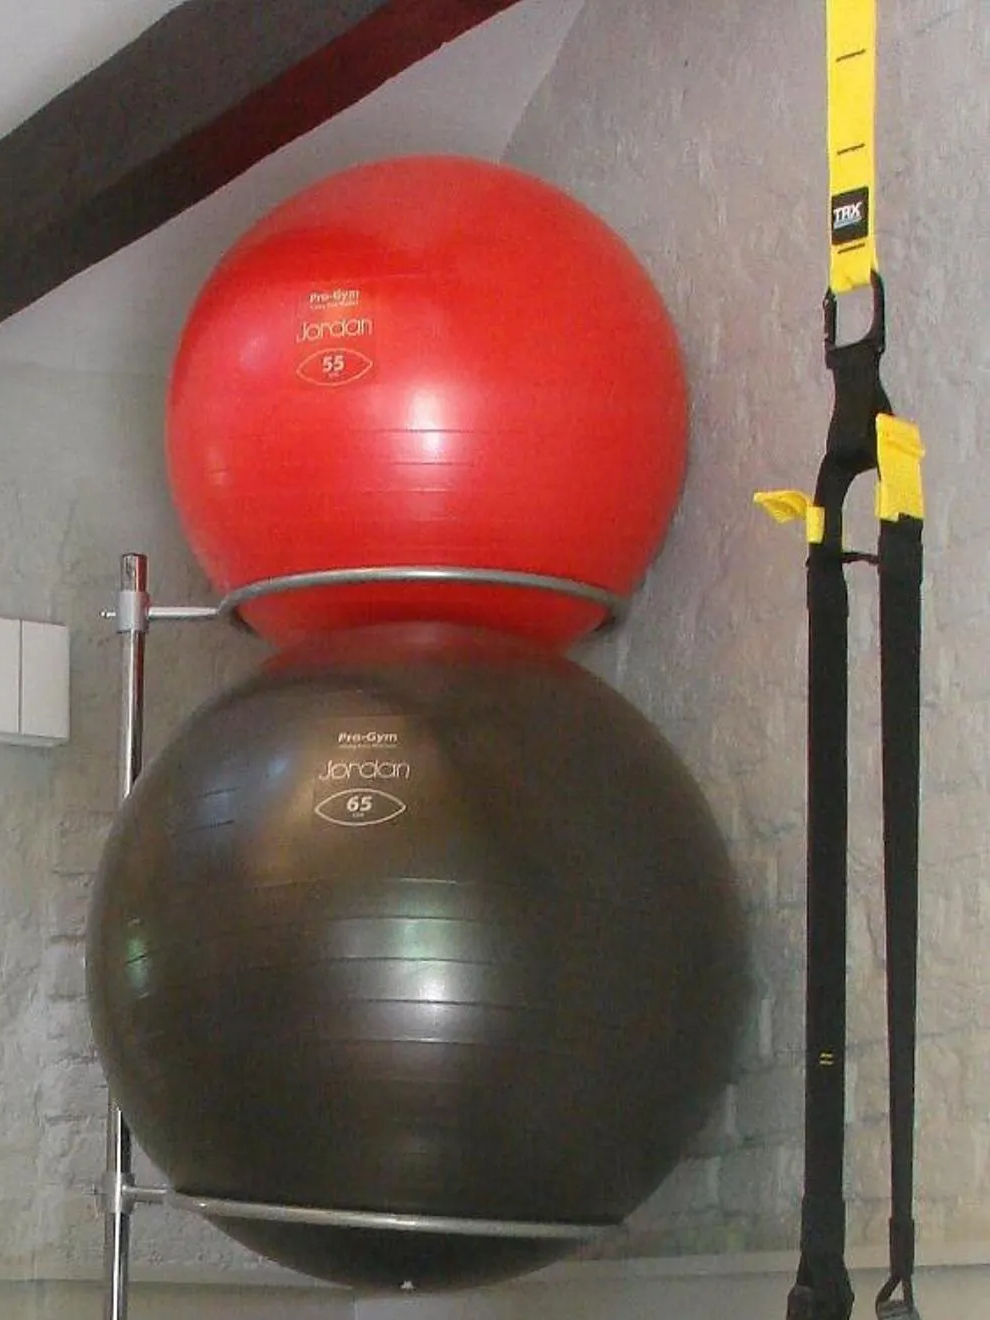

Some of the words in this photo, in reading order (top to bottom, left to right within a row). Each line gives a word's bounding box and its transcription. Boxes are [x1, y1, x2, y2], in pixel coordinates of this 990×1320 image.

[833, 201, 862, 221] TRX
[296, 319, 372, 343] Jordan
[322, 355, 344, 373] 55
[338, 731, 398, 744] Pro-Gym
[319, 760, 410, 780] Jordan
[346, 795, 373, 812] 65
